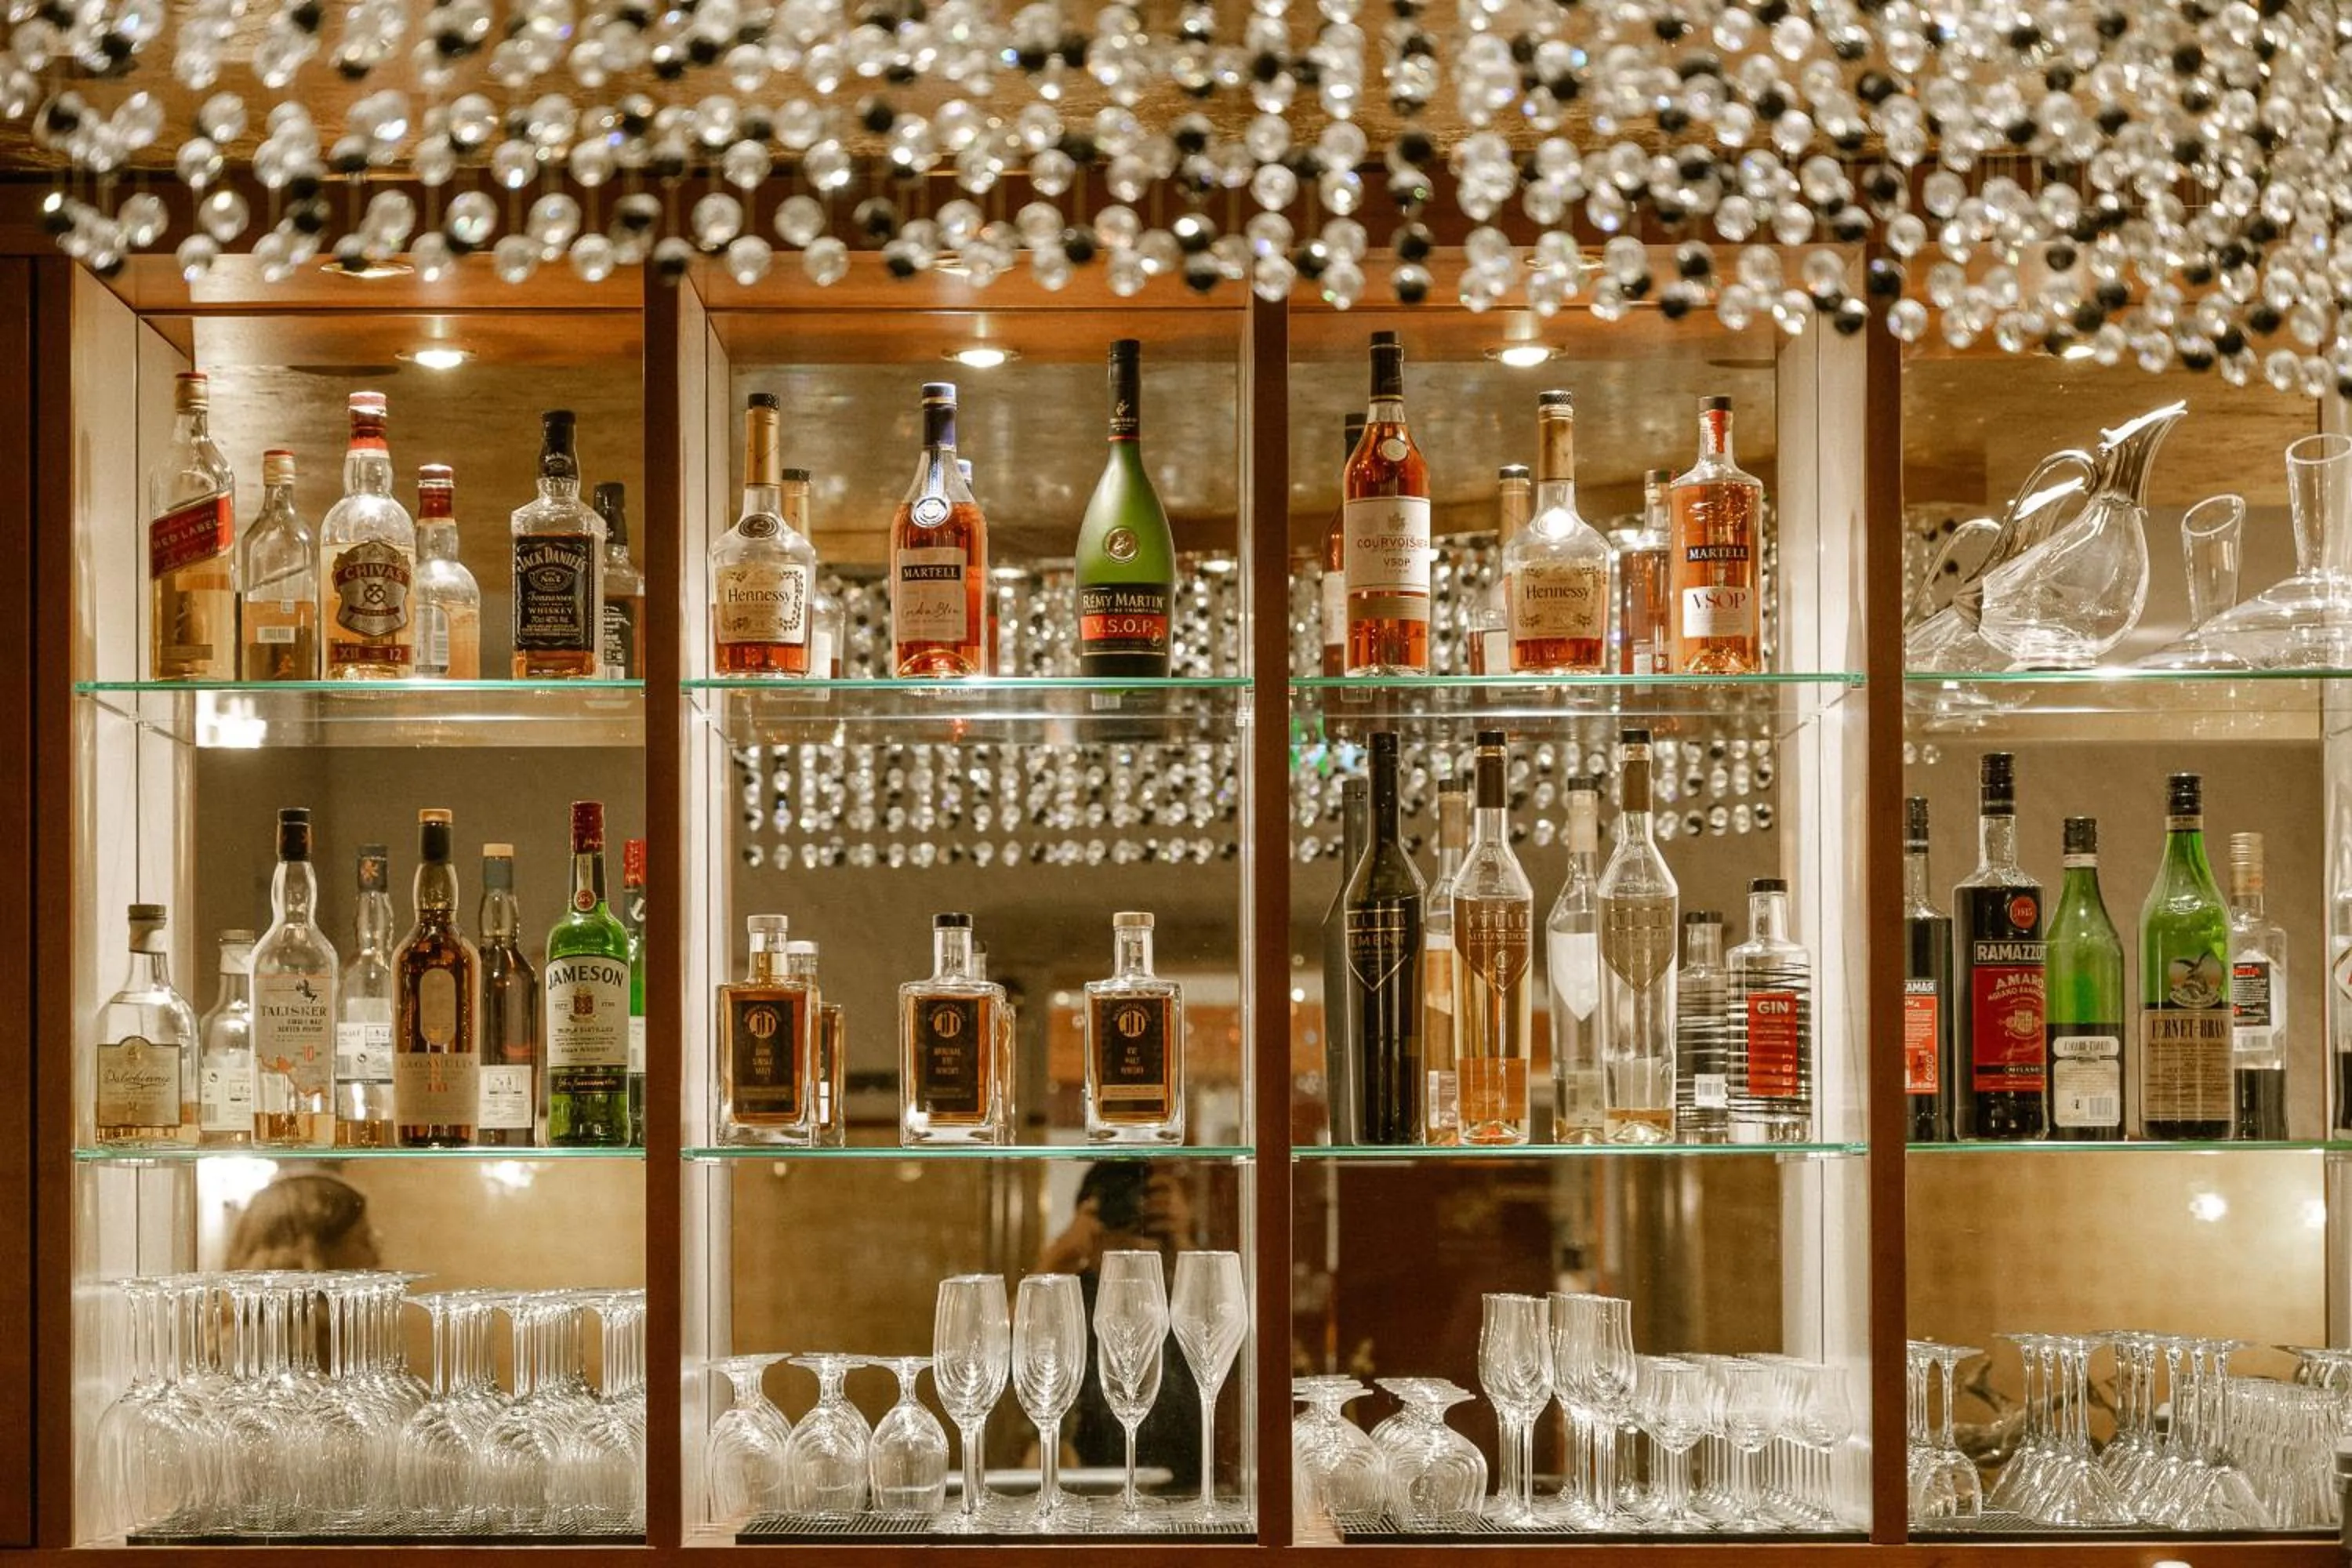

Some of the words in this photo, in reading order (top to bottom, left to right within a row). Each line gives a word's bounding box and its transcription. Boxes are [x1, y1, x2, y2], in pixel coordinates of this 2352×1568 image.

[180, 518, 223, 539] LABEL
[517, 551, 544, 572] JACK
[1689, 547, 1746, 560] MARTELL
[1383, 557, 1410, 567] VSOP
[345, 564, 403, 581] CHIVAS
[904, 567, 958, 578] MARTELL
[728, 588, 790, 604] Hennessy
[1115, 592, 1163, 608] MARTIN
[1526, 584, 1591, 601] Hennessy
[1693, 592, 1747, 609] VSOP
[389, 648, 402, 661] 12
[548, 965, 623, 989] JAMESON
[1995, 973, 2045, 990] AMARO
[260, 1004, 327, 1017] TALISKER
[1757, 1000, 1789, 1014] GIN
